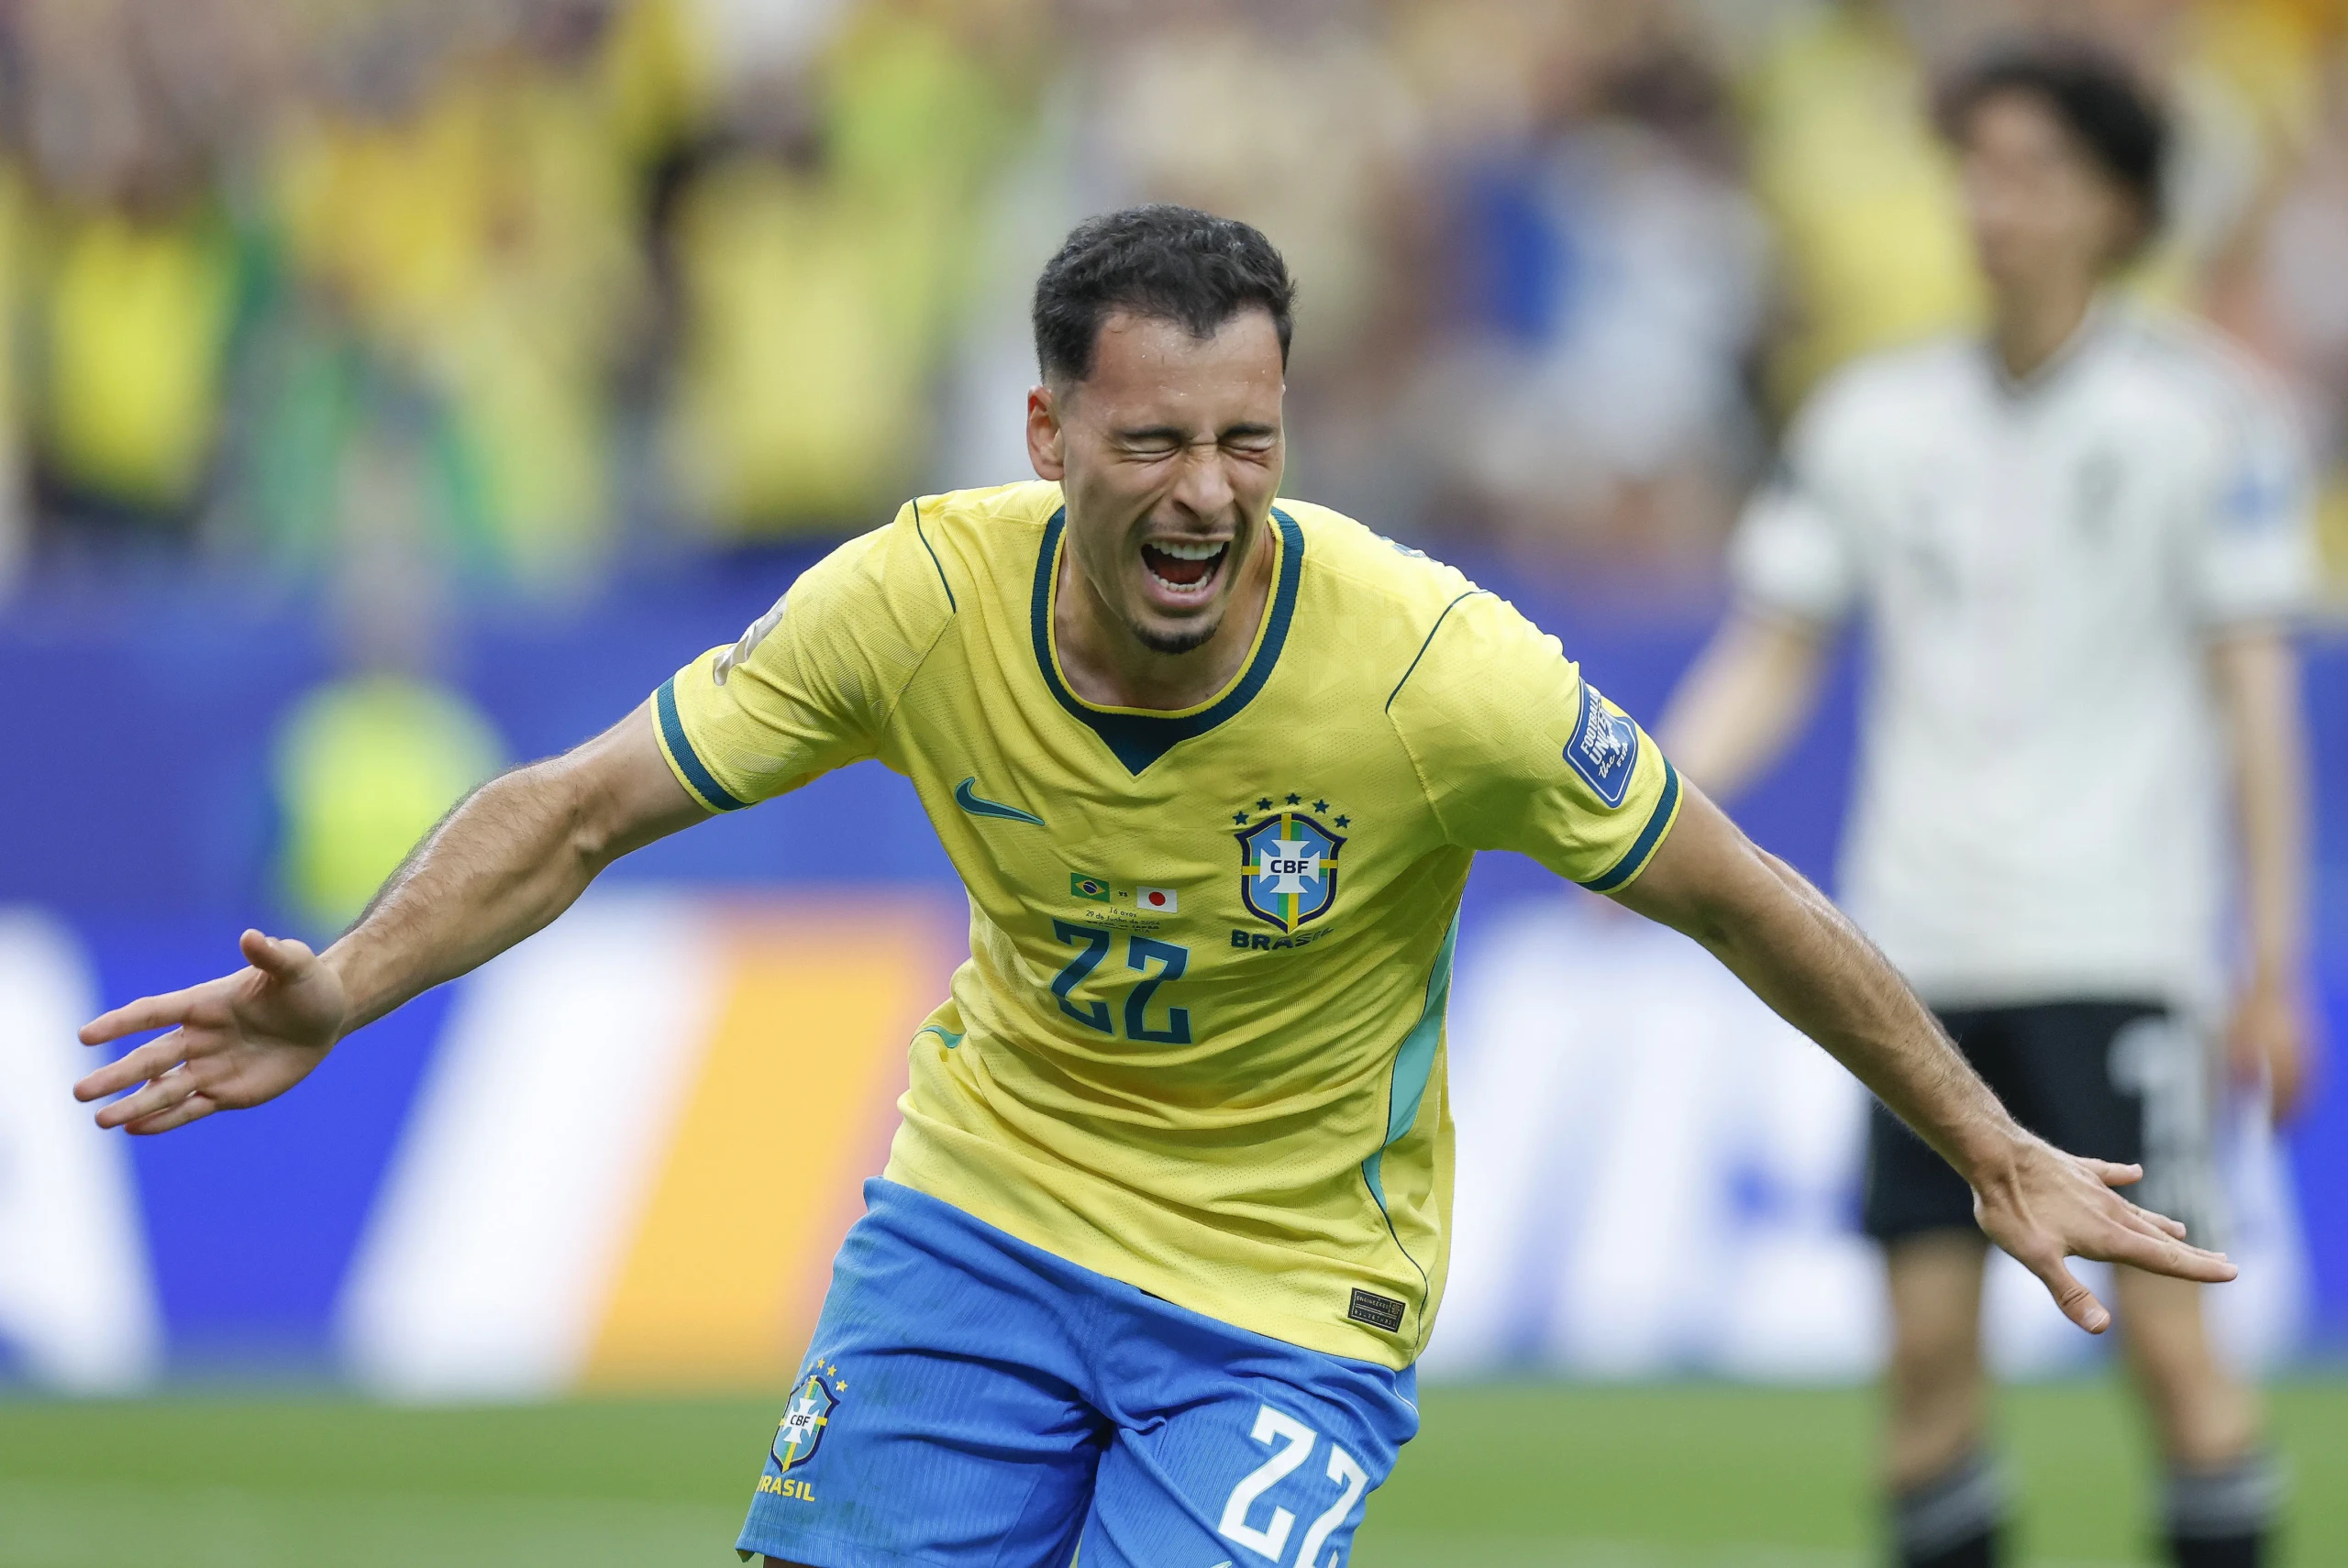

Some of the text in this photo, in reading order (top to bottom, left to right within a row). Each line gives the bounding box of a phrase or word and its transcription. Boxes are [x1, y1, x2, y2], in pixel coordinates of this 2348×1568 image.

[1598, 755, 1616, 778] the
[1270, 859, 1309, 874] CBF
[1109, 907, 1118, 915] 16
[1049, 919, 1191, 1044] 22
[790, 1414, 811, 1427] CBF
[1218, 1403, 1370, 1568] 22
